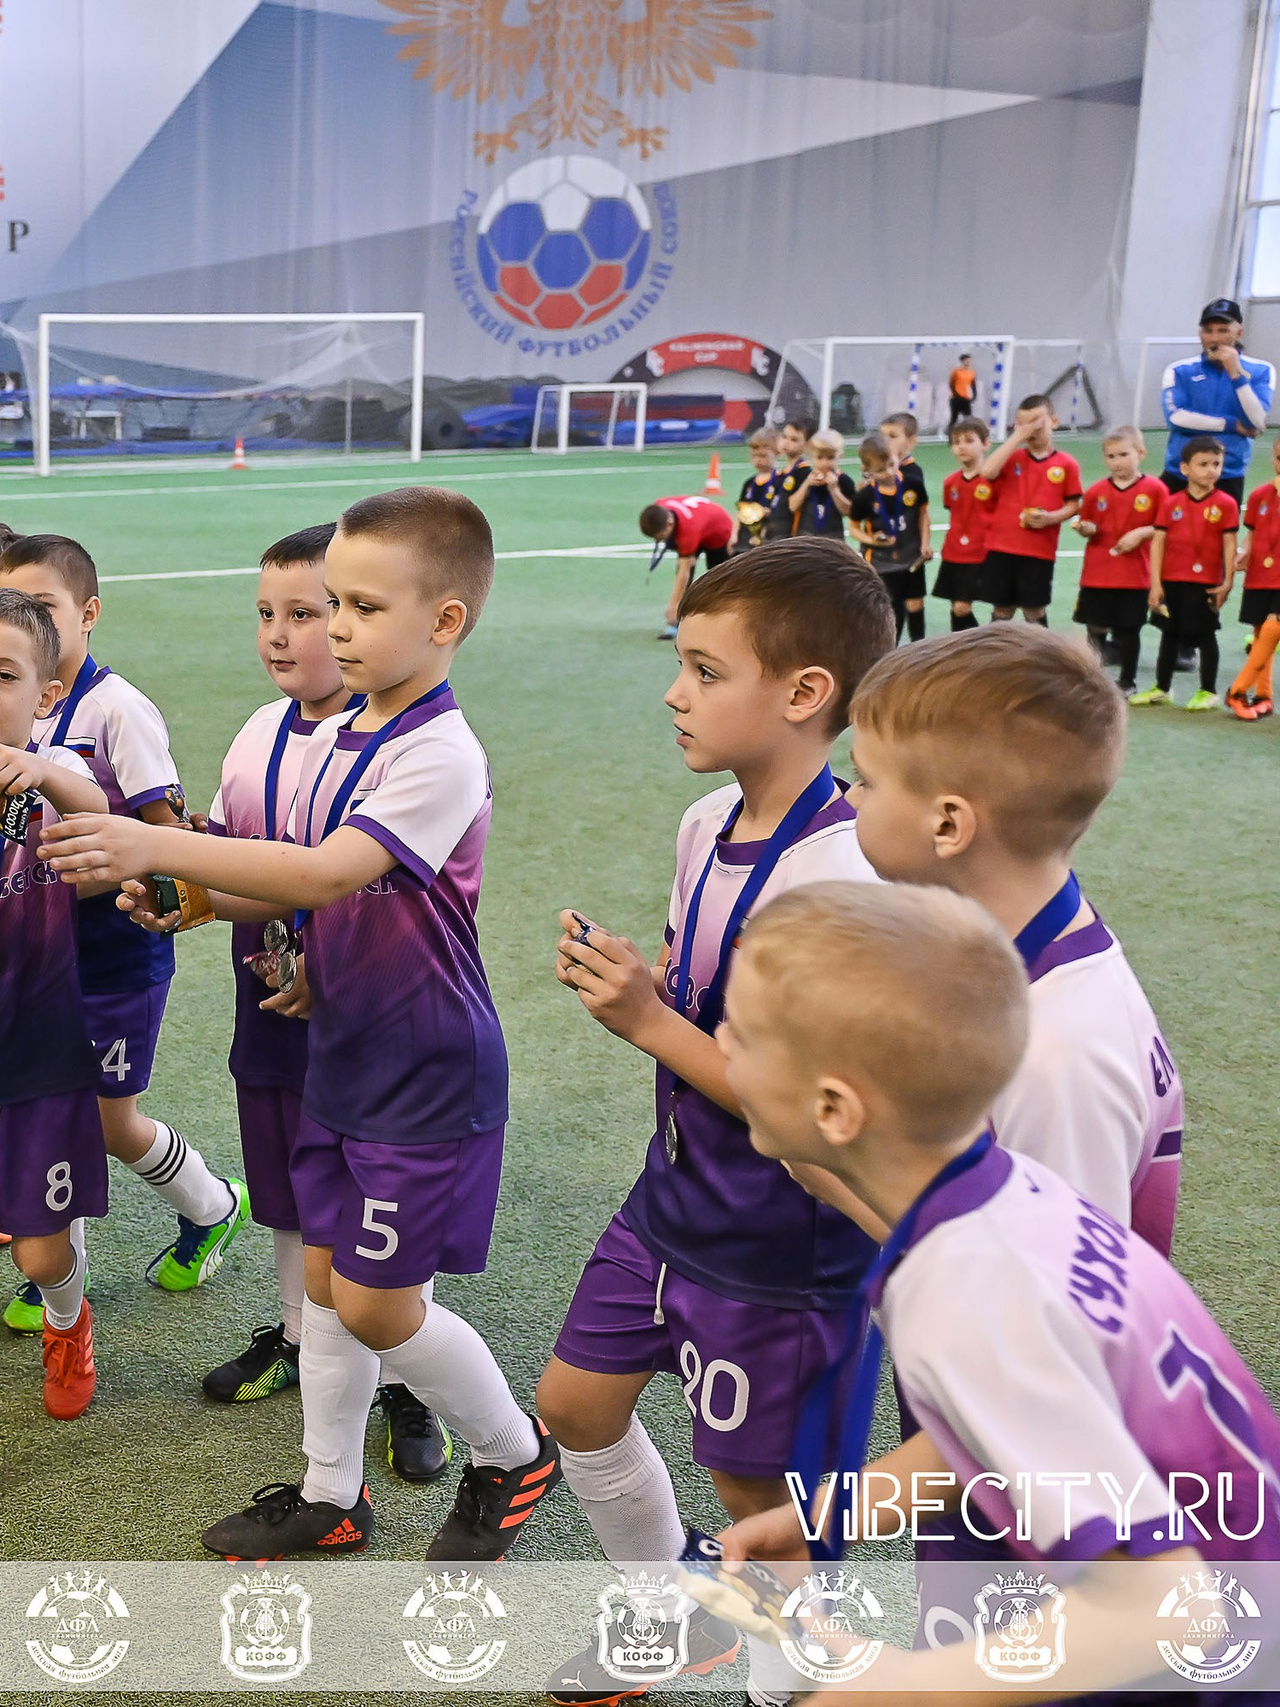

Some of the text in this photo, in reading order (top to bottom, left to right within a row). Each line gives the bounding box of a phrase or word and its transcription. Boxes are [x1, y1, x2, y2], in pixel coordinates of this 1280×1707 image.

[45, 1160, 73, 1212] 8
[355, 1197, 399, 1261] 5
[317, 1531, 363, 1546] adidas
